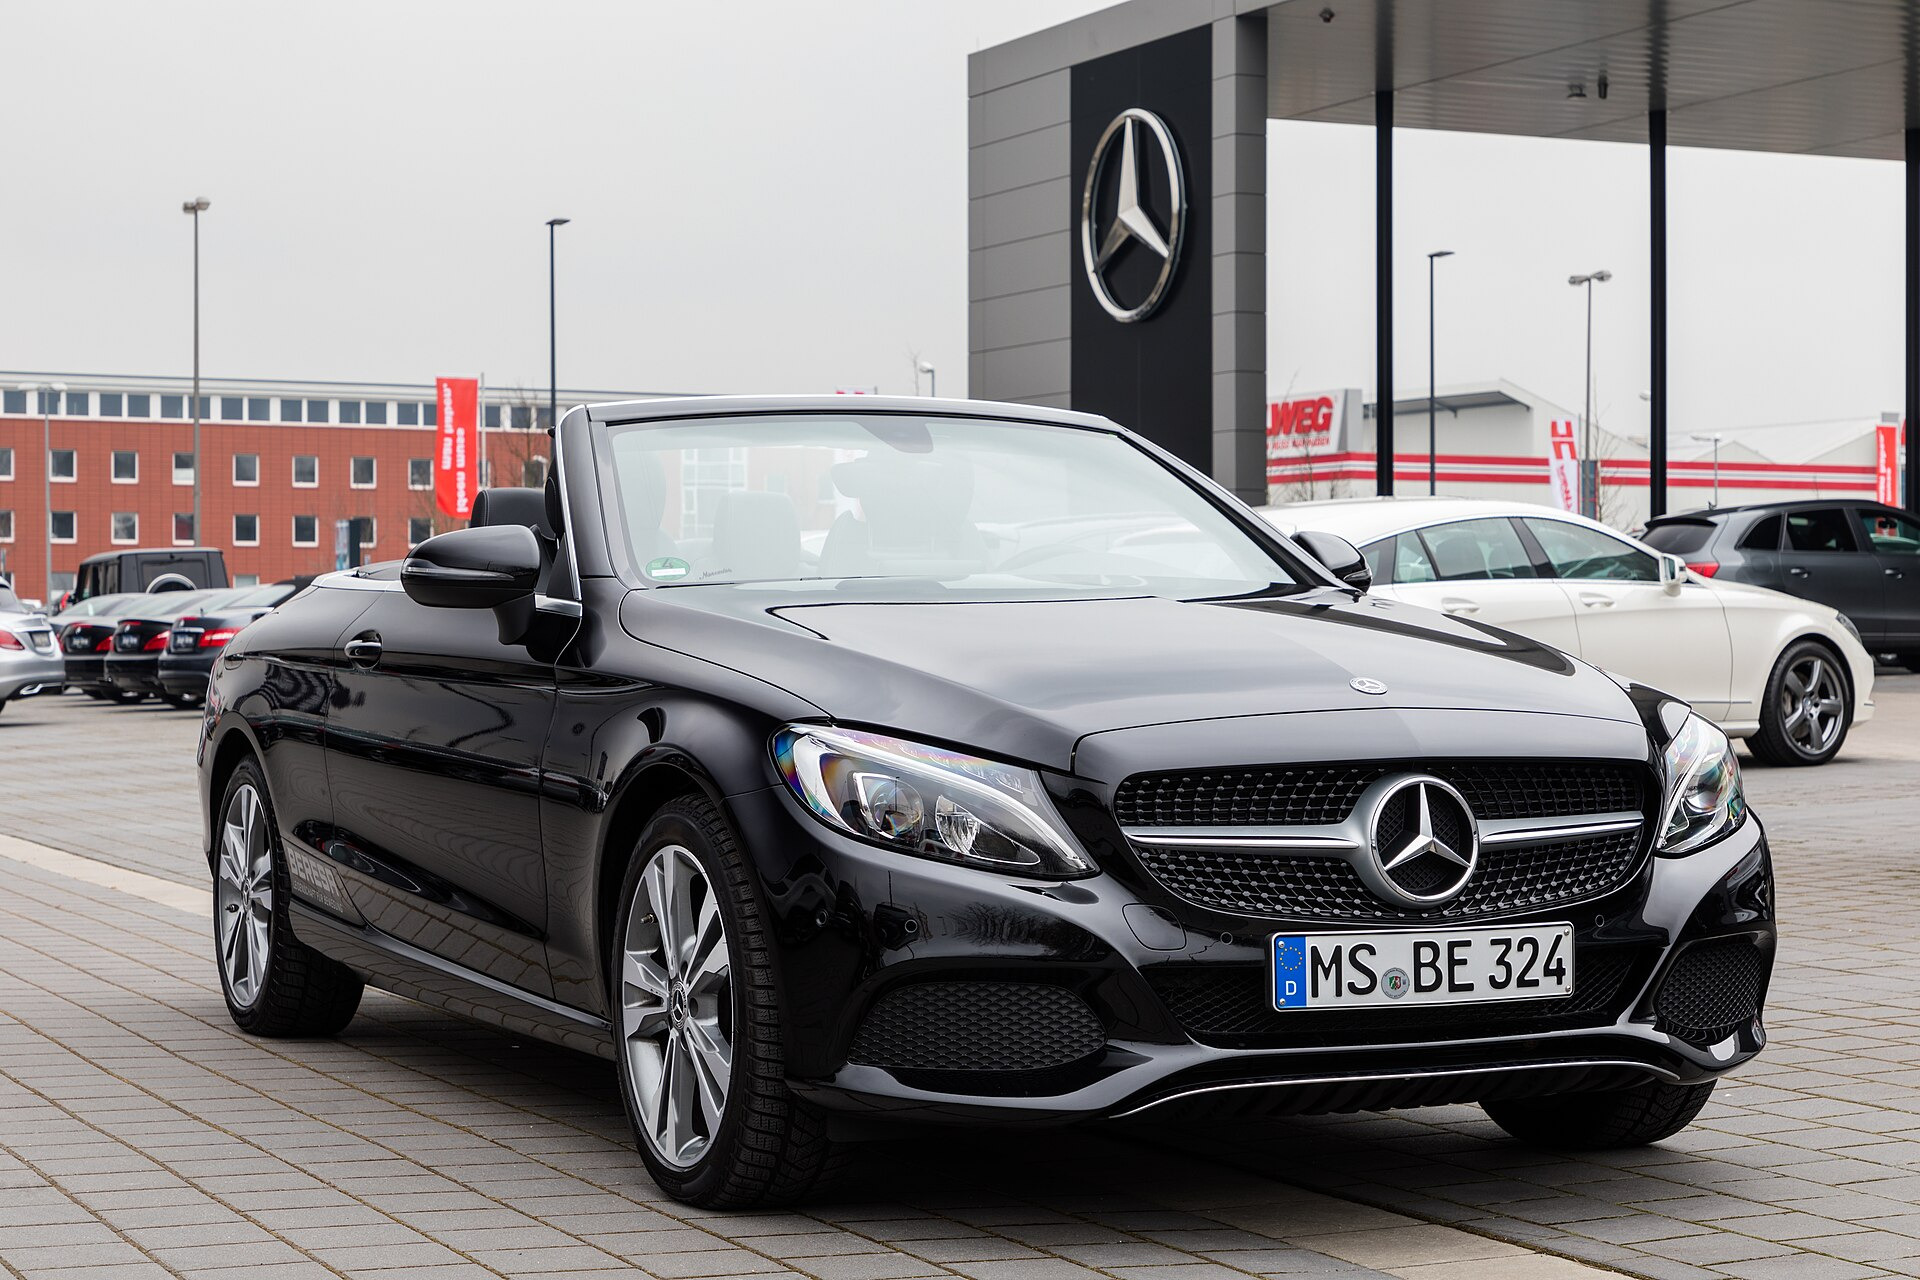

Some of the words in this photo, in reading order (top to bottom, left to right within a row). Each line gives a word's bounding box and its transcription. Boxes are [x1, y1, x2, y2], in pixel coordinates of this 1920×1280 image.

[286, 846, 340, 897] BERESA
[1286, 980, 1297, 996] D
[1310, 943, 1377, 998] MS
[1413, 939, 1475, 993] BE
[1488, 934, 1567, 989] 324
